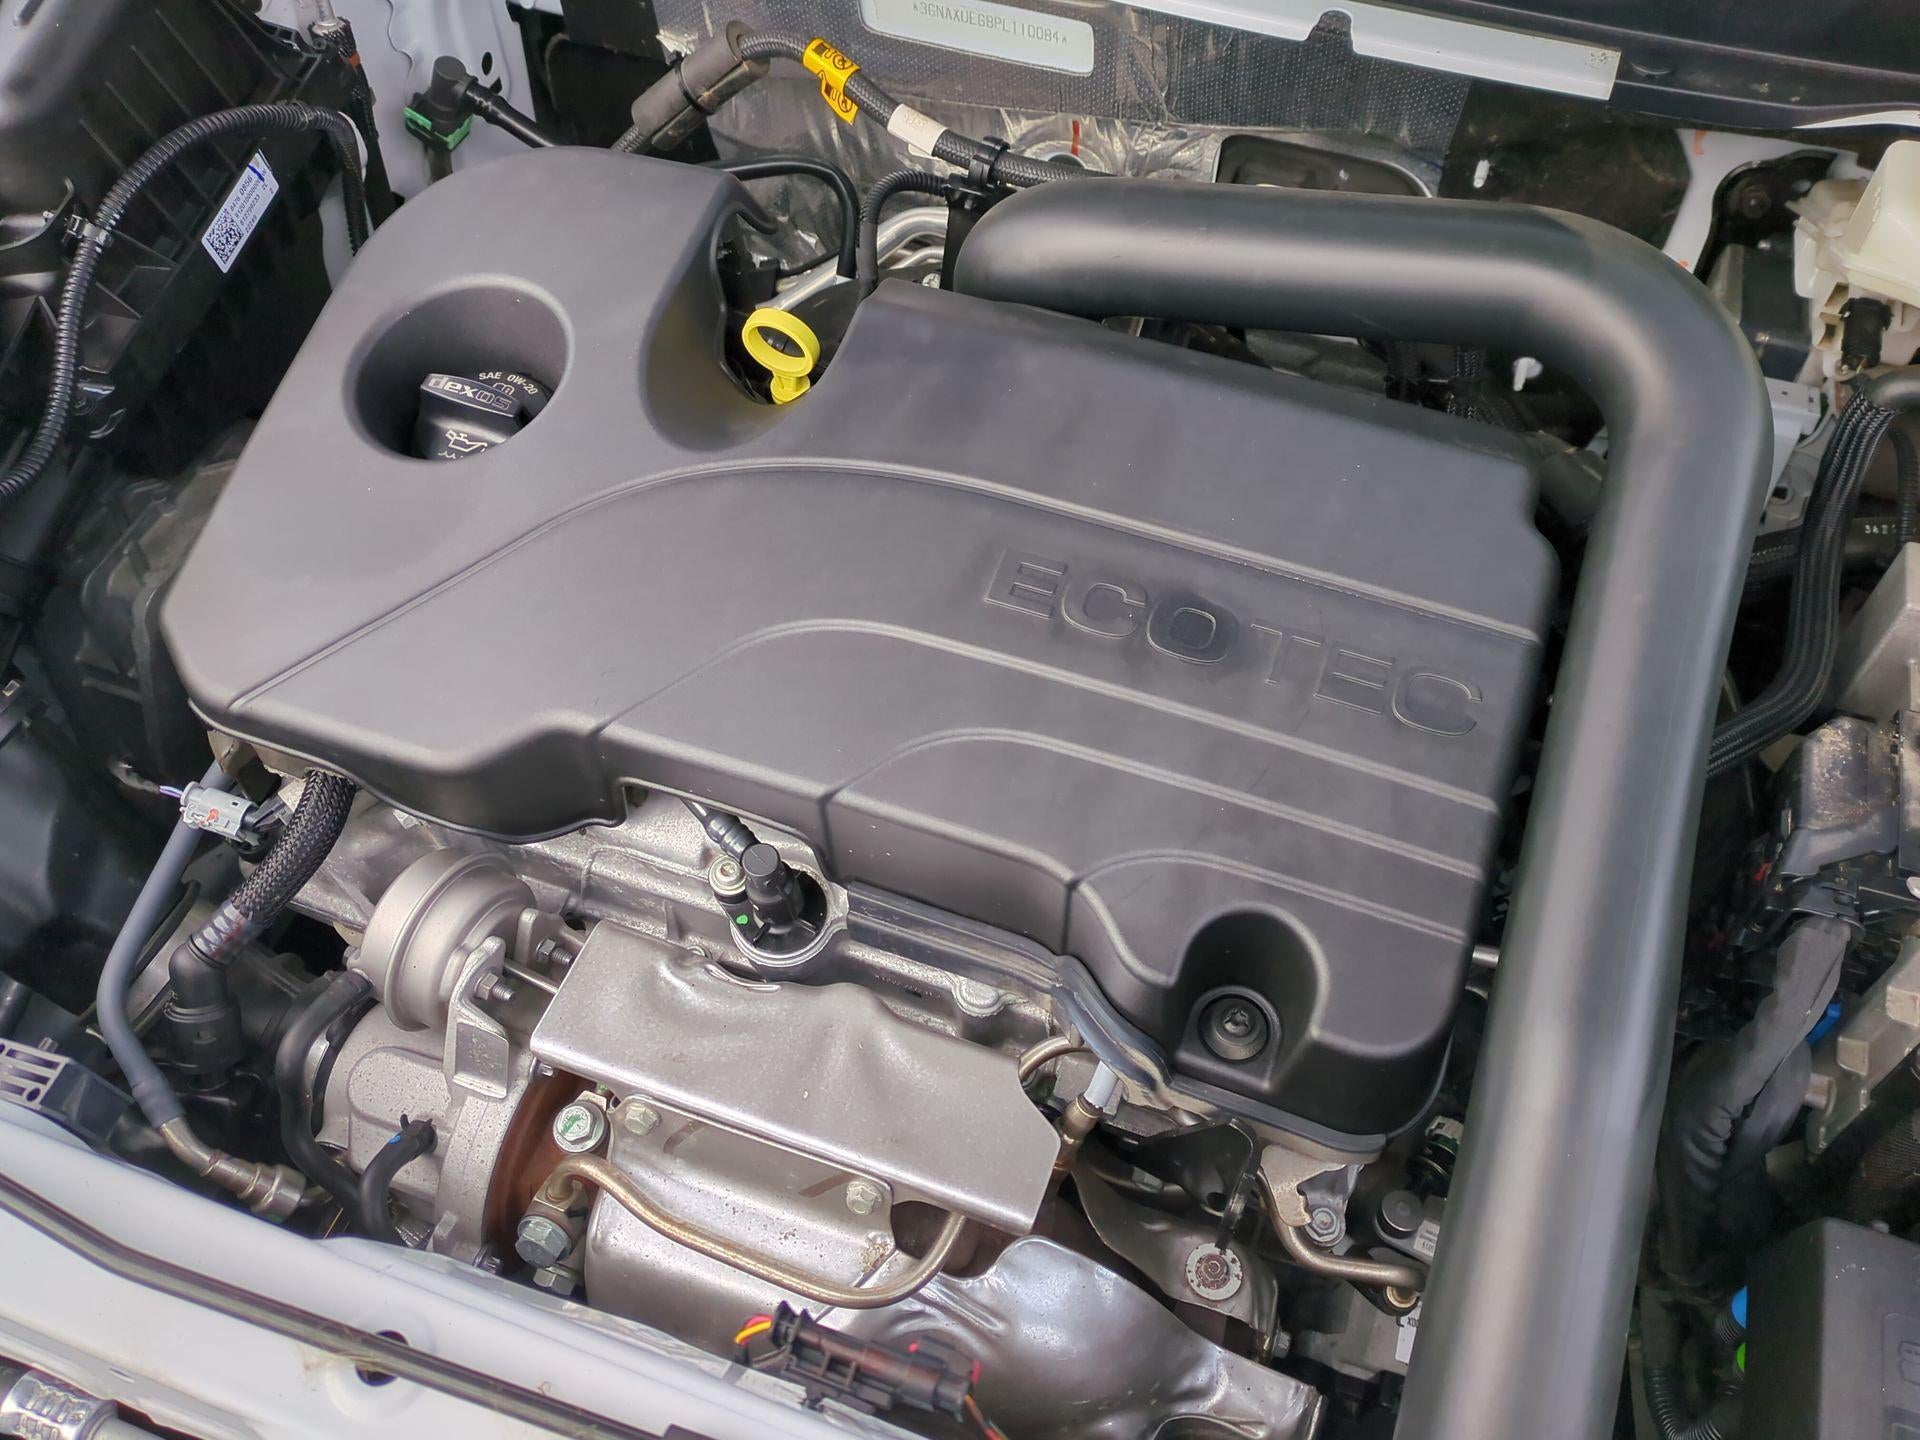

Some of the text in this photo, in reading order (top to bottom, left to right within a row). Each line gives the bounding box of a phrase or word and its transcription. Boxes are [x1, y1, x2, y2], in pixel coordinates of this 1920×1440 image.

[428, 377, 512, 411] dexos
[479, 372, 539, 395] SAE 0W-20
[983, 548, 1483, 737] ECOTEC
